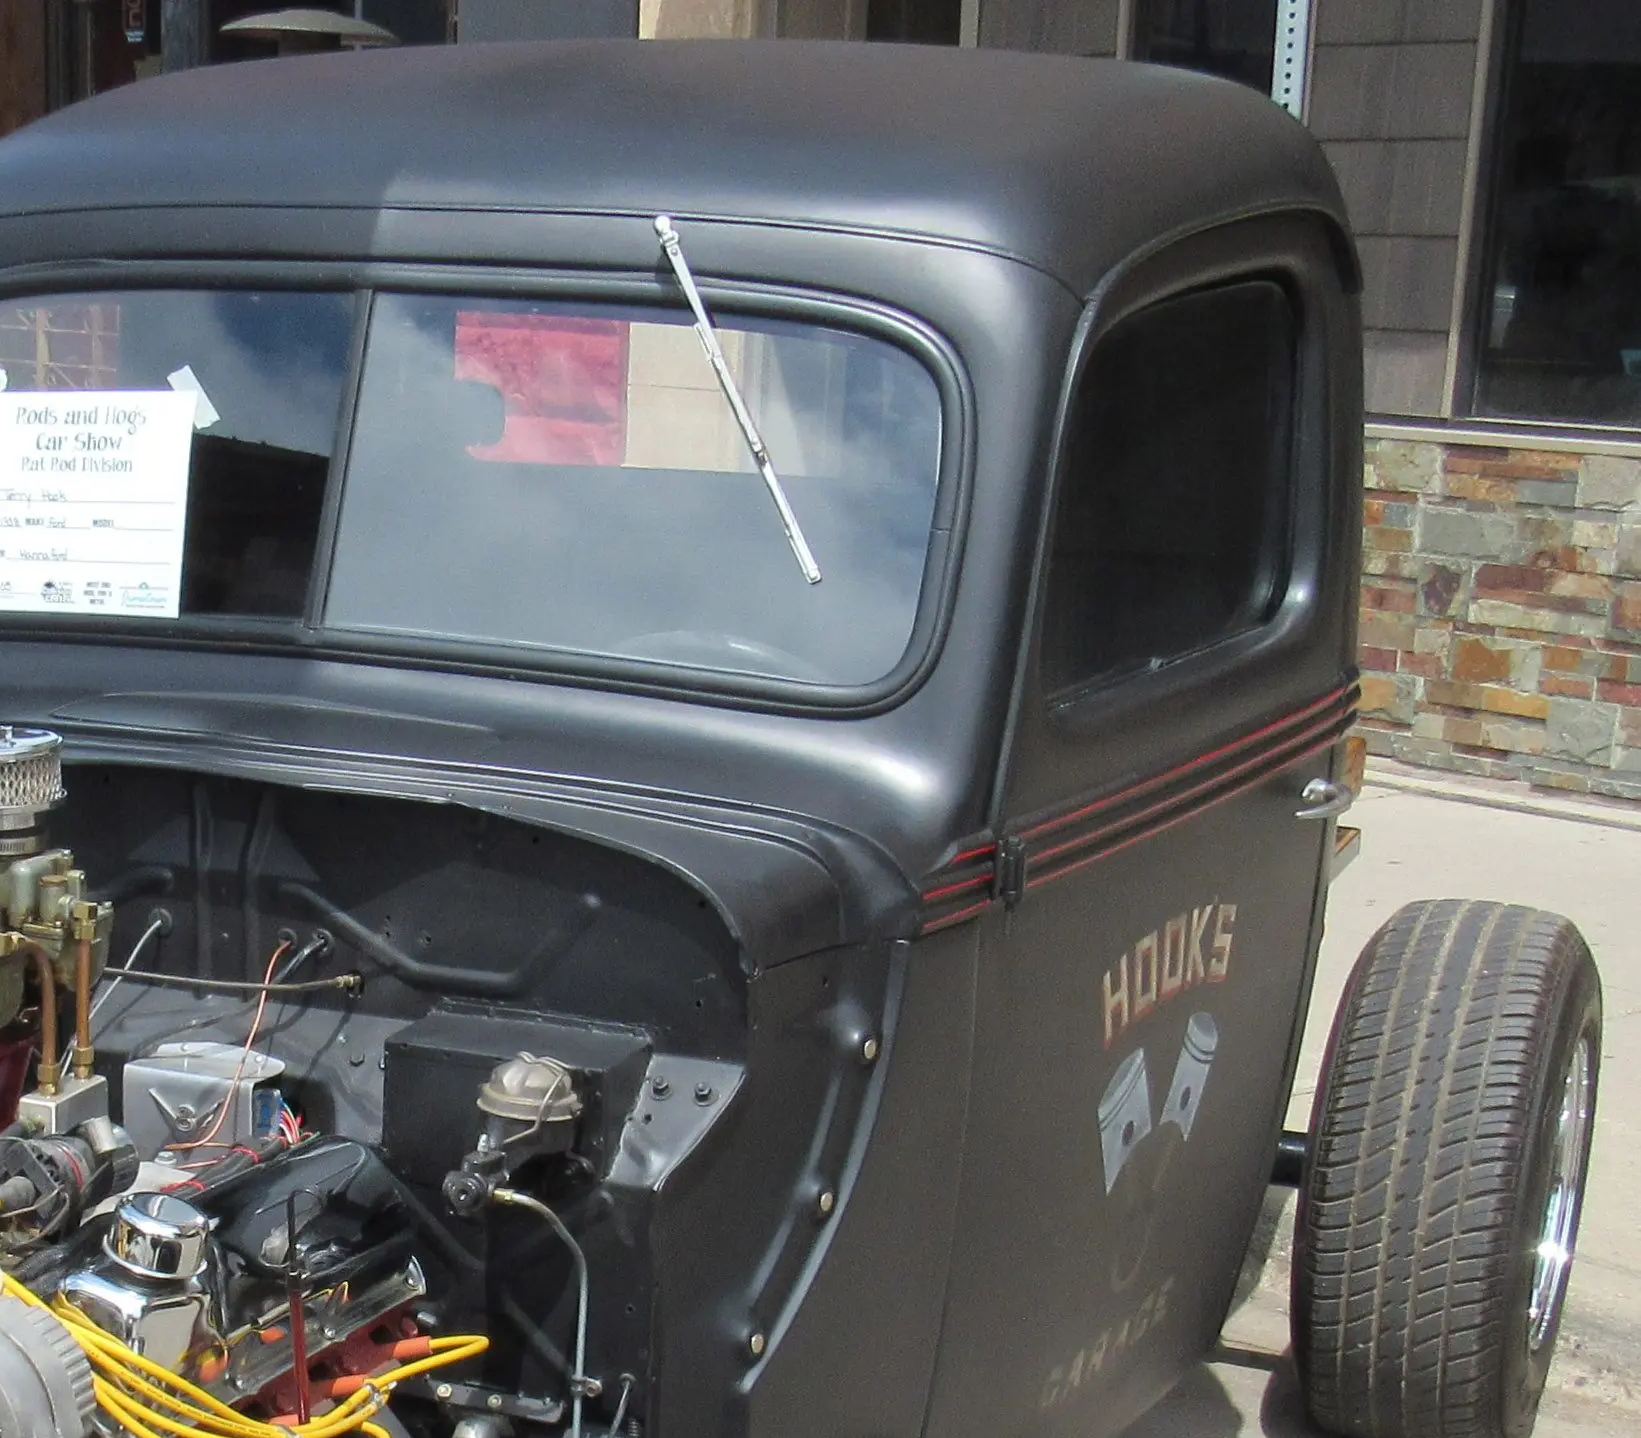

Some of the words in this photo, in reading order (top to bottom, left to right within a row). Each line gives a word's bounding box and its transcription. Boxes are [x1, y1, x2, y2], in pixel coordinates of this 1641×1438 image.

[16, 406, 58, 425] Rods
[64, 406, 98, 425] and
[36, 432, 68, 451] Car
[74, 432, 123, 451] Show
[21, 456, 45, 472] Rat
[50, 456, 77, 472] Rod
[81, 457, 133, 473] Division
